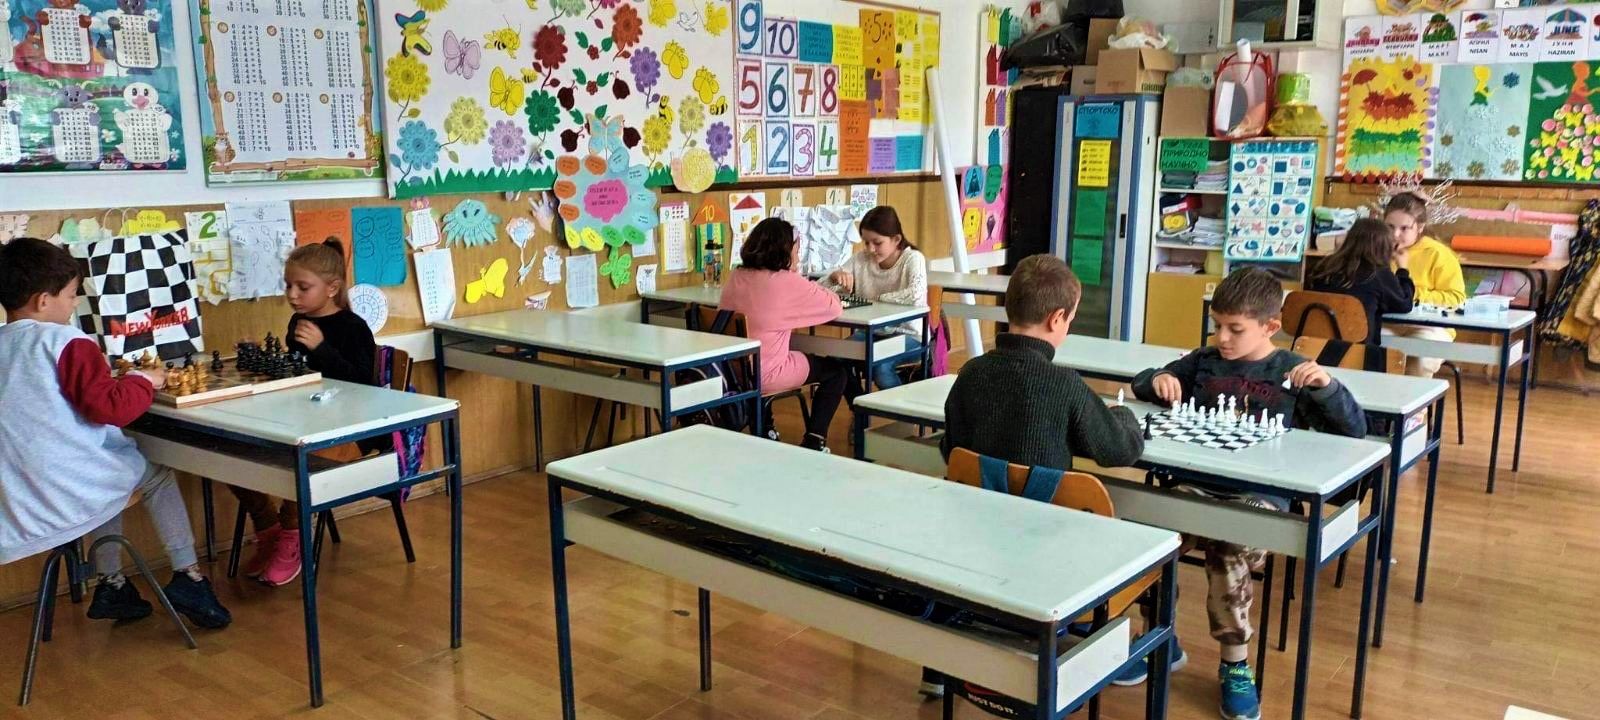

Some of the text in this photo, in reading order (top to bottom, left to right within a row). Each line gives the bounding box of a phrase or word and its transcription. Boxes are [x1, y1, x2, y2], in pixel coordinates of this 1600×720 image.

[740, 2, 760, 50] 9
[767, 22, 795, 56] 10
[872, 13, 882, 43] 5
[1550, 25, 1580, 35] JUNE
[739, 65, 760, 110] 5
[768, 66, 787, 113] 6
[795, 67, 813, 113] 7
[821, 68, 837, 113] 8
[742, 124, 757, 171] 1
[769, 126, 788, 168] 2
[794, 128, 813, 173] 3
[819, 125, 837, 167] 4
[1246, 142, 1311, 153] SHAPES
[198, 212, 218, 239] 2
[664, 210, 670, 220] 9
[701, 204, 714, 222] 10
